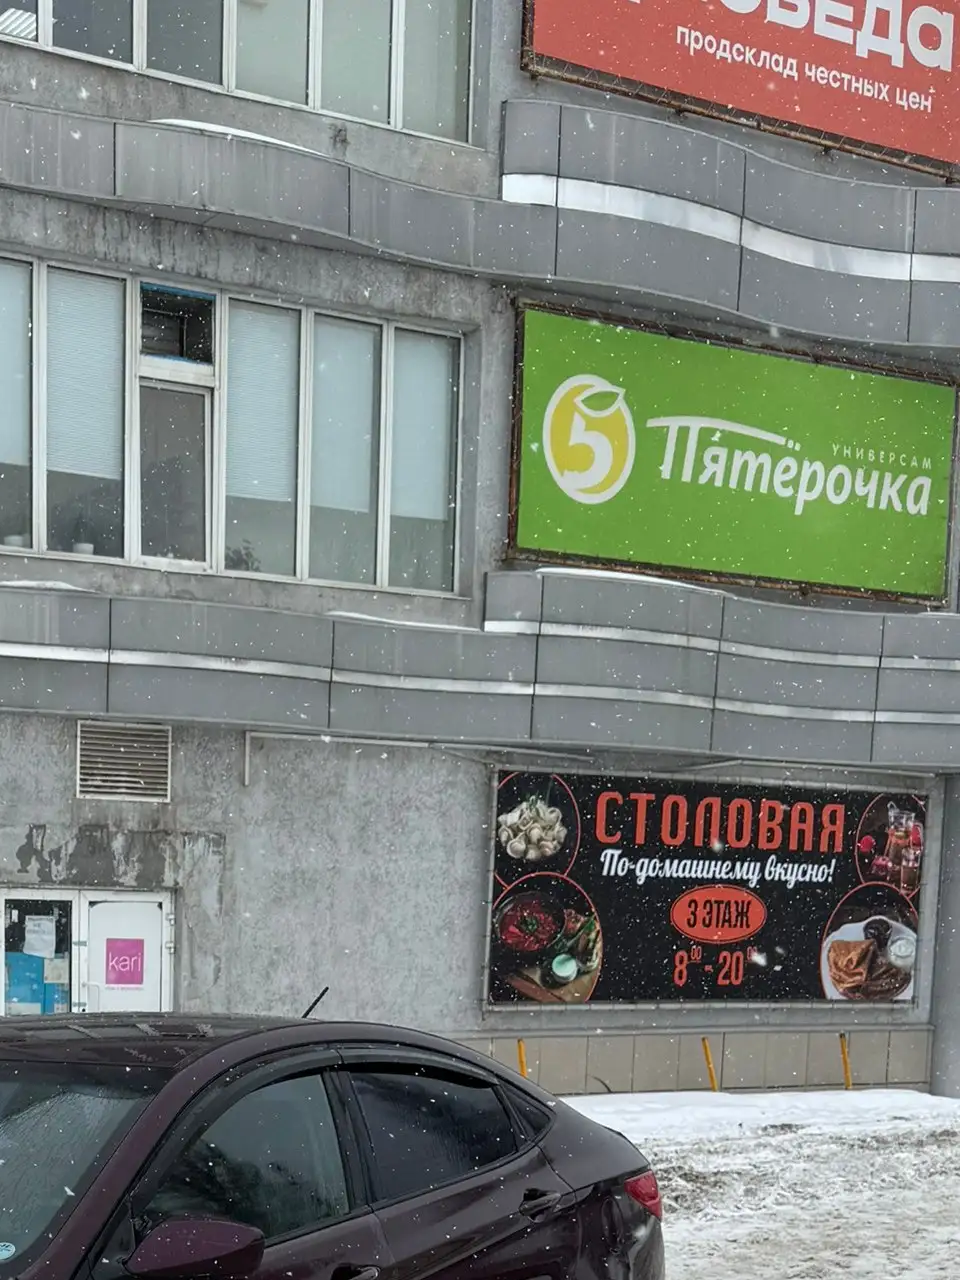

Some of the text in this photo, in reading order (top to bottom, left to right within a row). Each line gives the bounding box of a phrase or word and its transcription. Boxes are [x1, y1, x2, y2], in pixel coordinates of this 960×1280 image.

[675, 25, 933, 113] продсклад честных цен
[646, 416, 932, 516] Пятёрочка
[831, 443, 933, 471] УНИВЕРСАМ
[595, 791, 845, 853] СТОЛОВАЯ
[600, 849, 837, 889] По-домашнему вкусно!
[686, 900, 752, 929] 3 ЭТАЖ
[108, 952, 142, 972] kari
